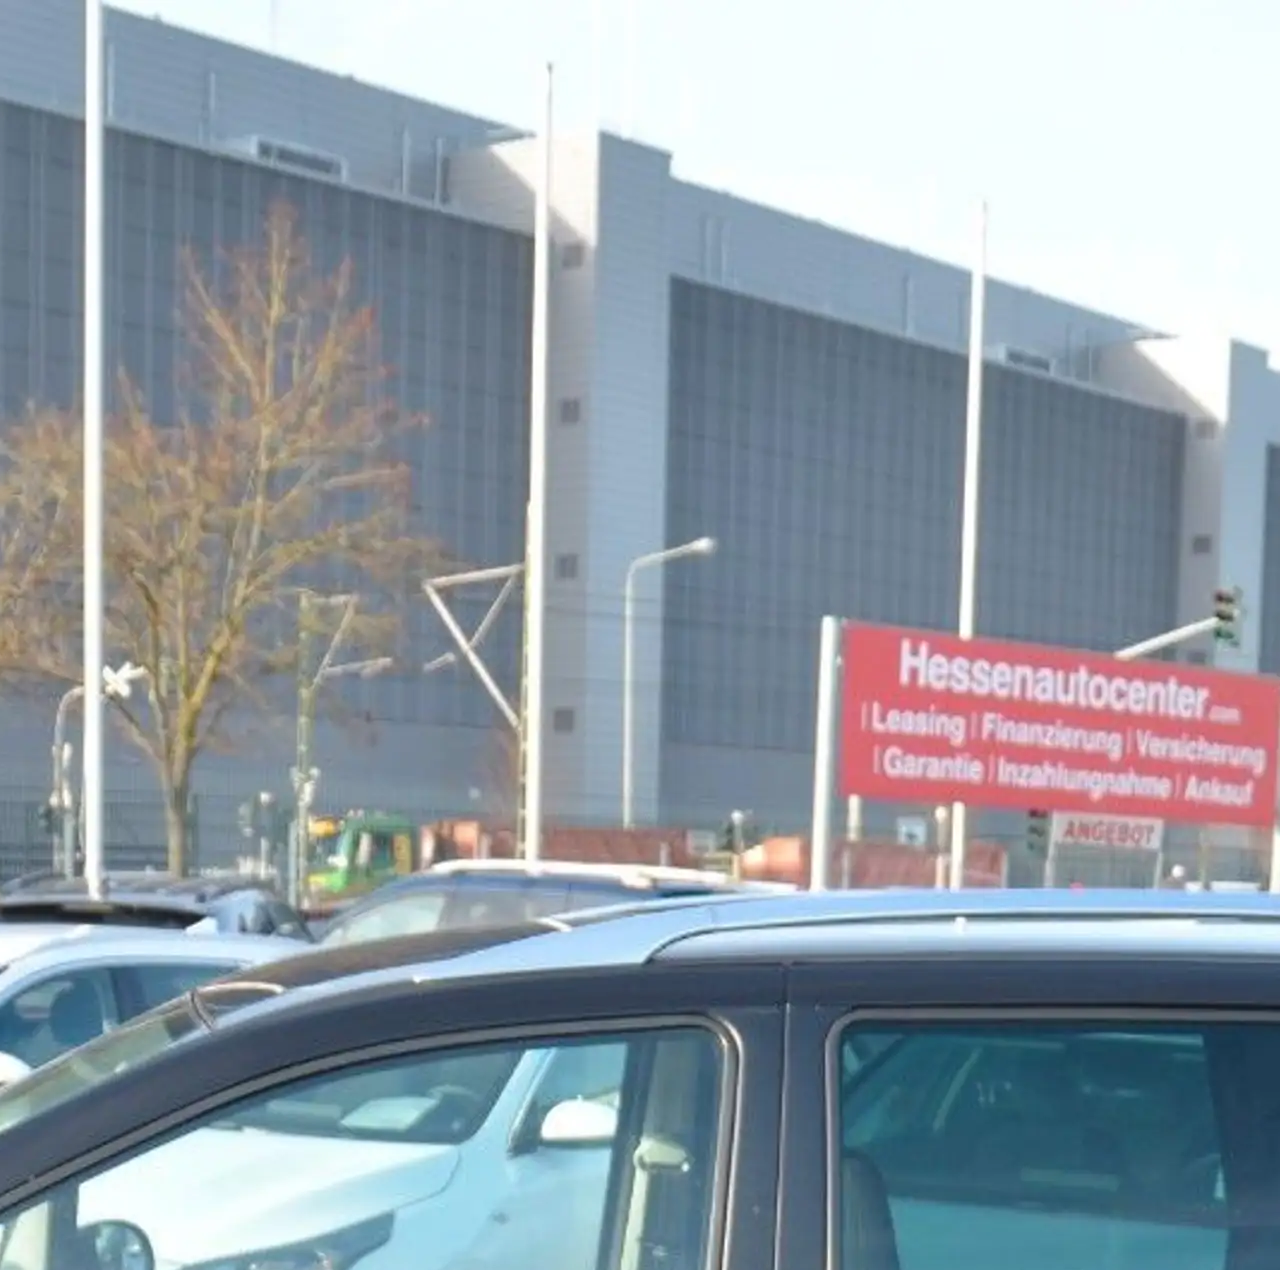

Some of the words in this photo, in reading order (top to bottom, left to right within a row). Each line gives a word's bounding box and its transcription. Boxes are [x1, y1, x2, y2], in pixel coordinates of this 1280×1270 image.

[899, 637, 1209, 720] Hessenautocenter
[872, 701, 966, 747] Leasing
[981, 710, 1123, 763] Finanzierung
[1136, 728, 1266, 777] Versicherung
[883, 746, 985, 784] Garantie
[998, 756, 1172, 802] Inzahlungnahme
[1185, 775, 1254, 807] Ankauf
[1063, 819, 1155, 846] ANGEBOT
